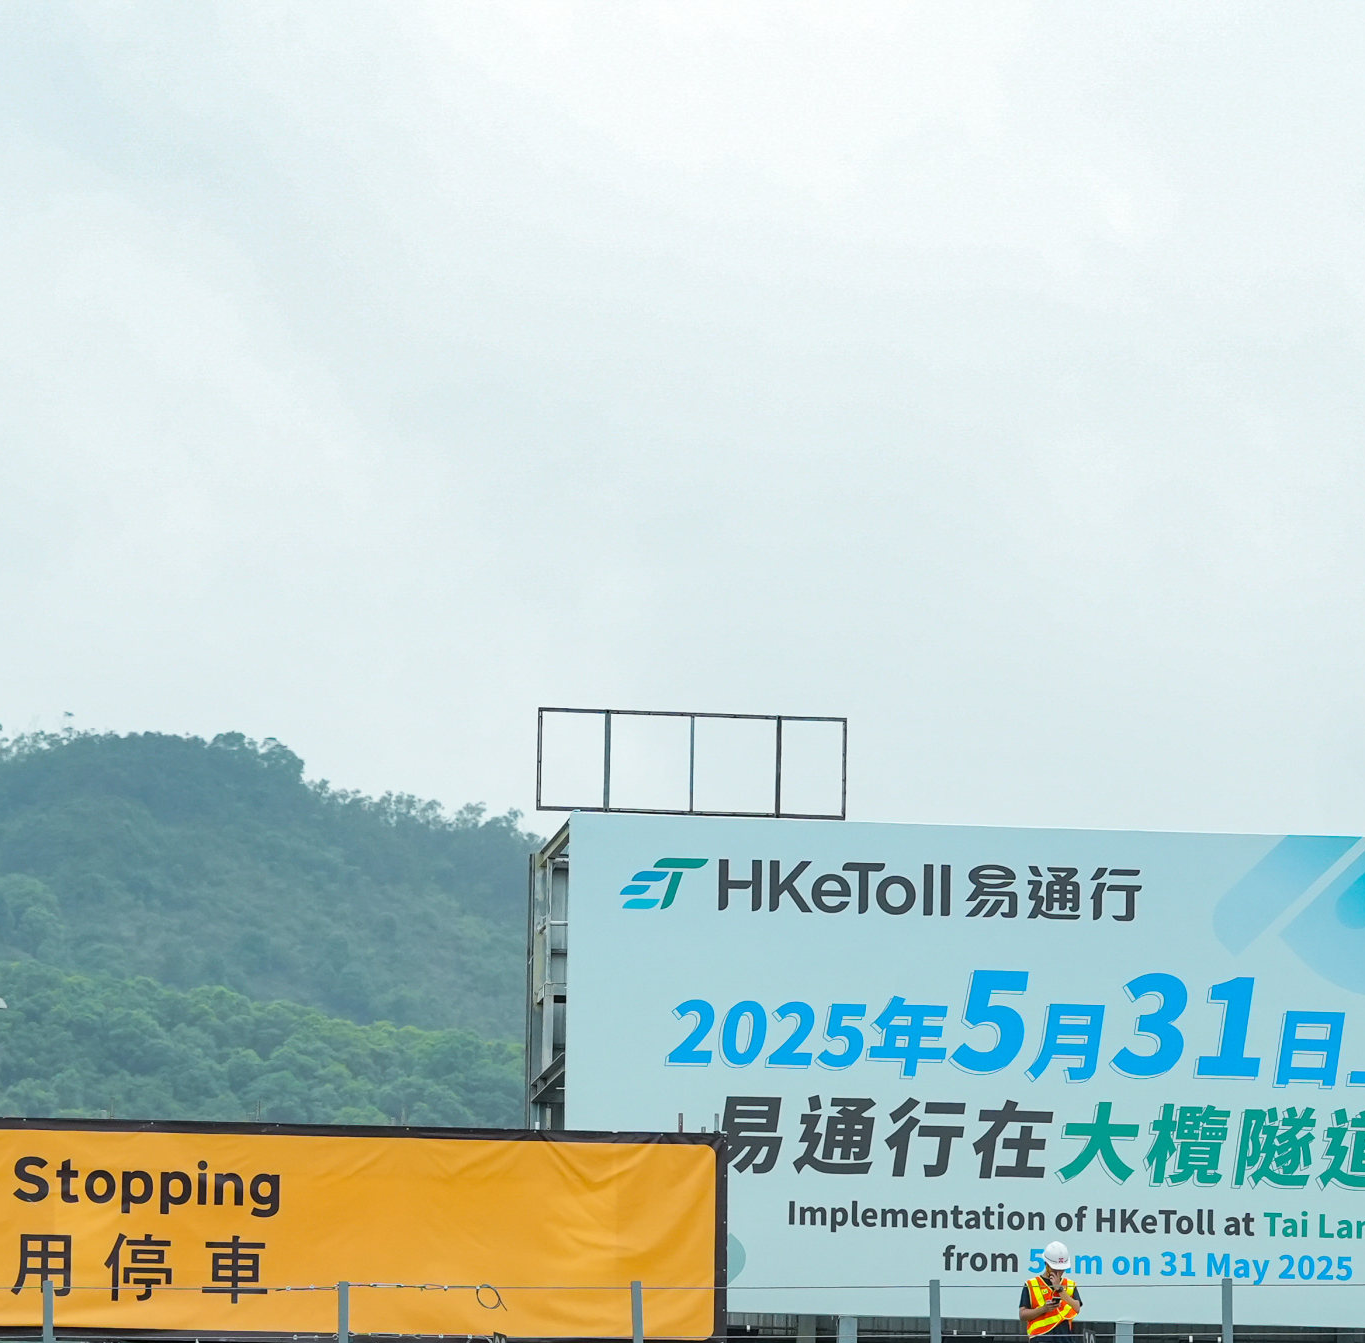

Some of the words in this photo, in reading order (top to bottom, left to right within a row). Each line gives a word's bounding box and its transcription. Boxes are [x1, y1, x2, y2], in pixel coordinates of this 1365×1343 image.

[717, 858, 952, 917] HKeToll
[965, 864, 1143, 922] 易通行
[12, 1155, 281, 1218] Stopping
[788, 1200, 1046, 1232] Implementation
[1054, 1206, 1088, 1233] of
[1095, 1207, 1216, 1236] HKeToll
[1223, 1212, 1255, 1237] at
[1263, 1210, 1309, 1238] Tai
[942, 1244, 1019, 1273] from
[1027, 1248, 1103, 1275] 5m
[1112, 1253, 1151, 1276] on
[1159, 1251, 1196, 1277] 31
[1206, 1252, 1270, 1286] May
[1278, 1254, 1353, 1281] 2025
